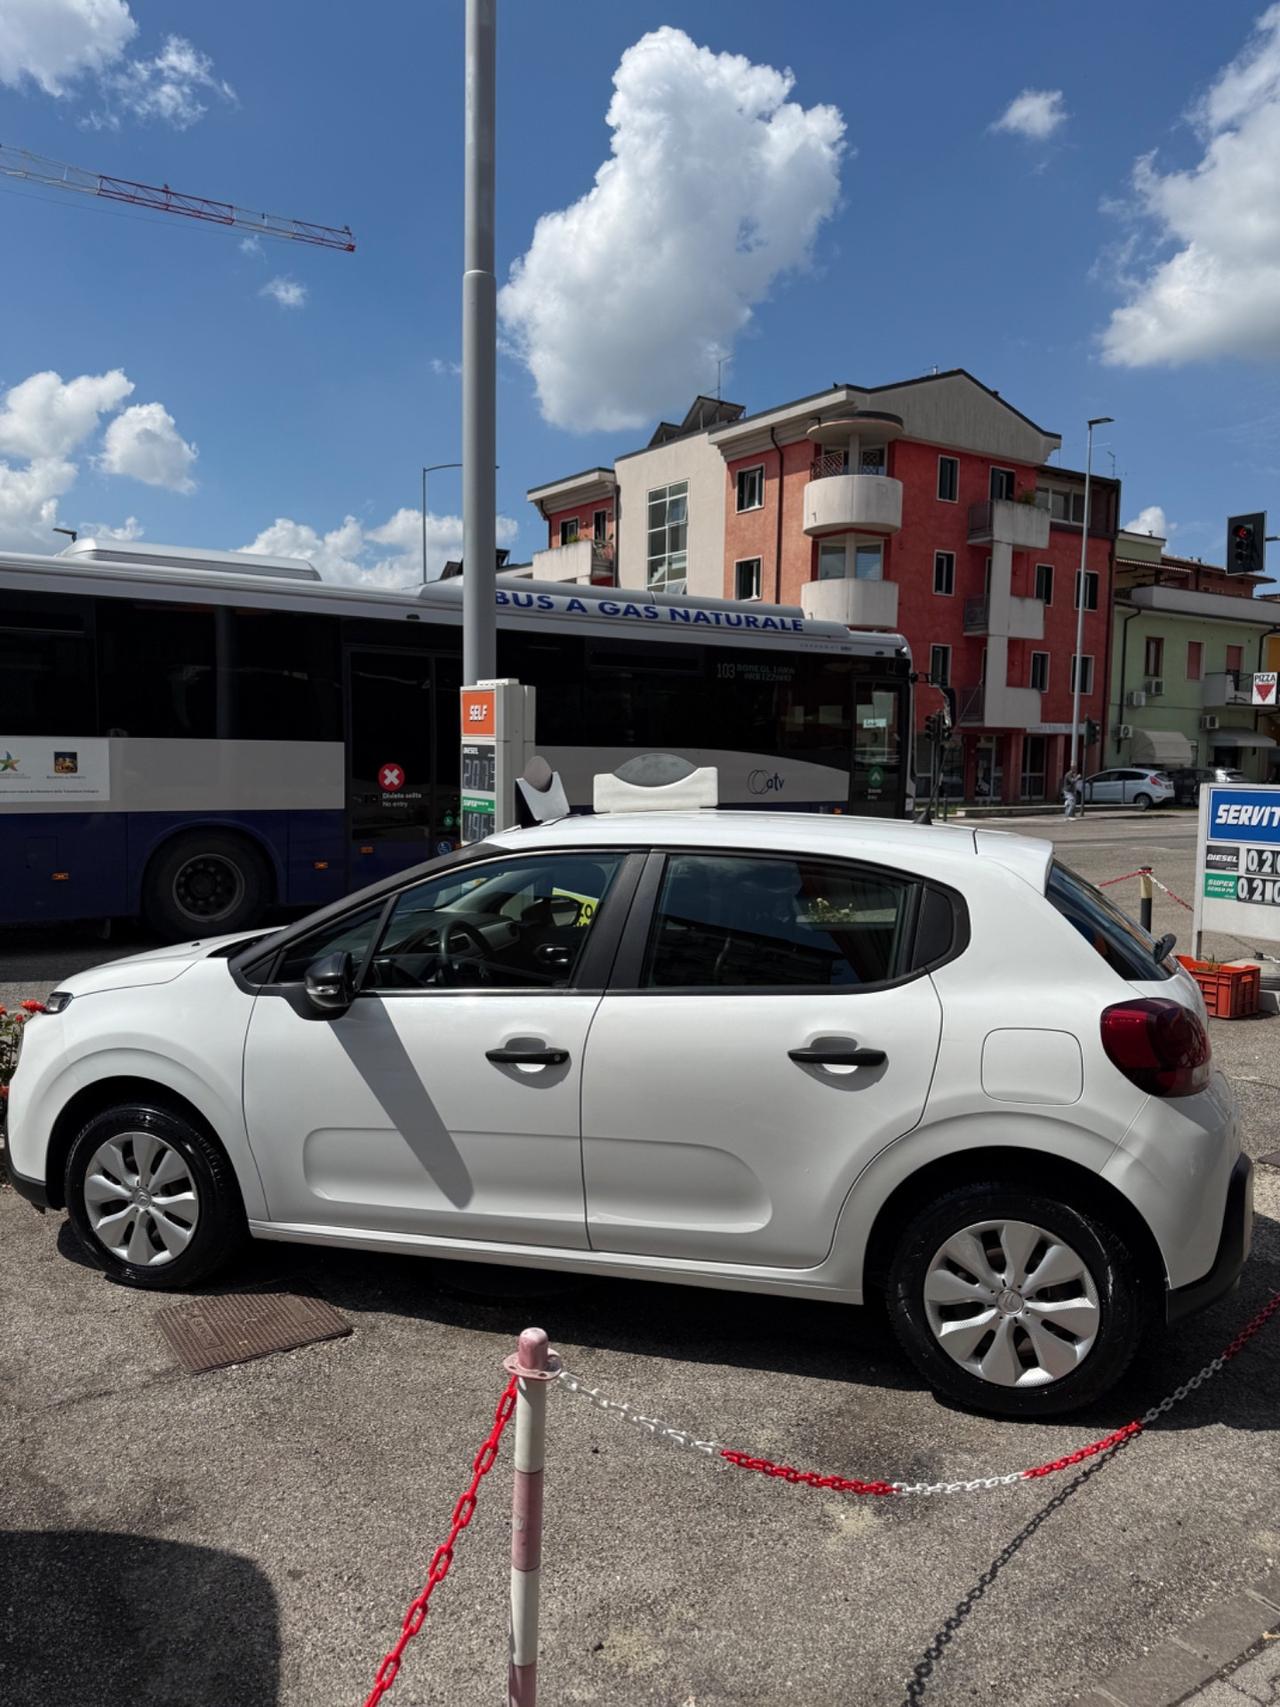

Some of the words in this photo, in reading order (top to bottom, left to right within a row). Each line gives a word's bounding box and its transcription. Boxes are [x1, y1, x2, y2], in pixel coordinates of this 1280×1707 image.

[495, 590, 554, 610] BUS
[565, 598, 588, 613] A
[599, 601, 658, 620] GAS
[669, 608, 804, 632] NATURALE
[716, 663, 735, 679] 103
[1254, 674, 1276, 683] PIZZA
[469, 704, 488, 721] SELF
[766, 772, 785, 791] atv
[1206, 853, 1238, 863] DIESEL
[1208, 879, 1235, 887] SUPER
